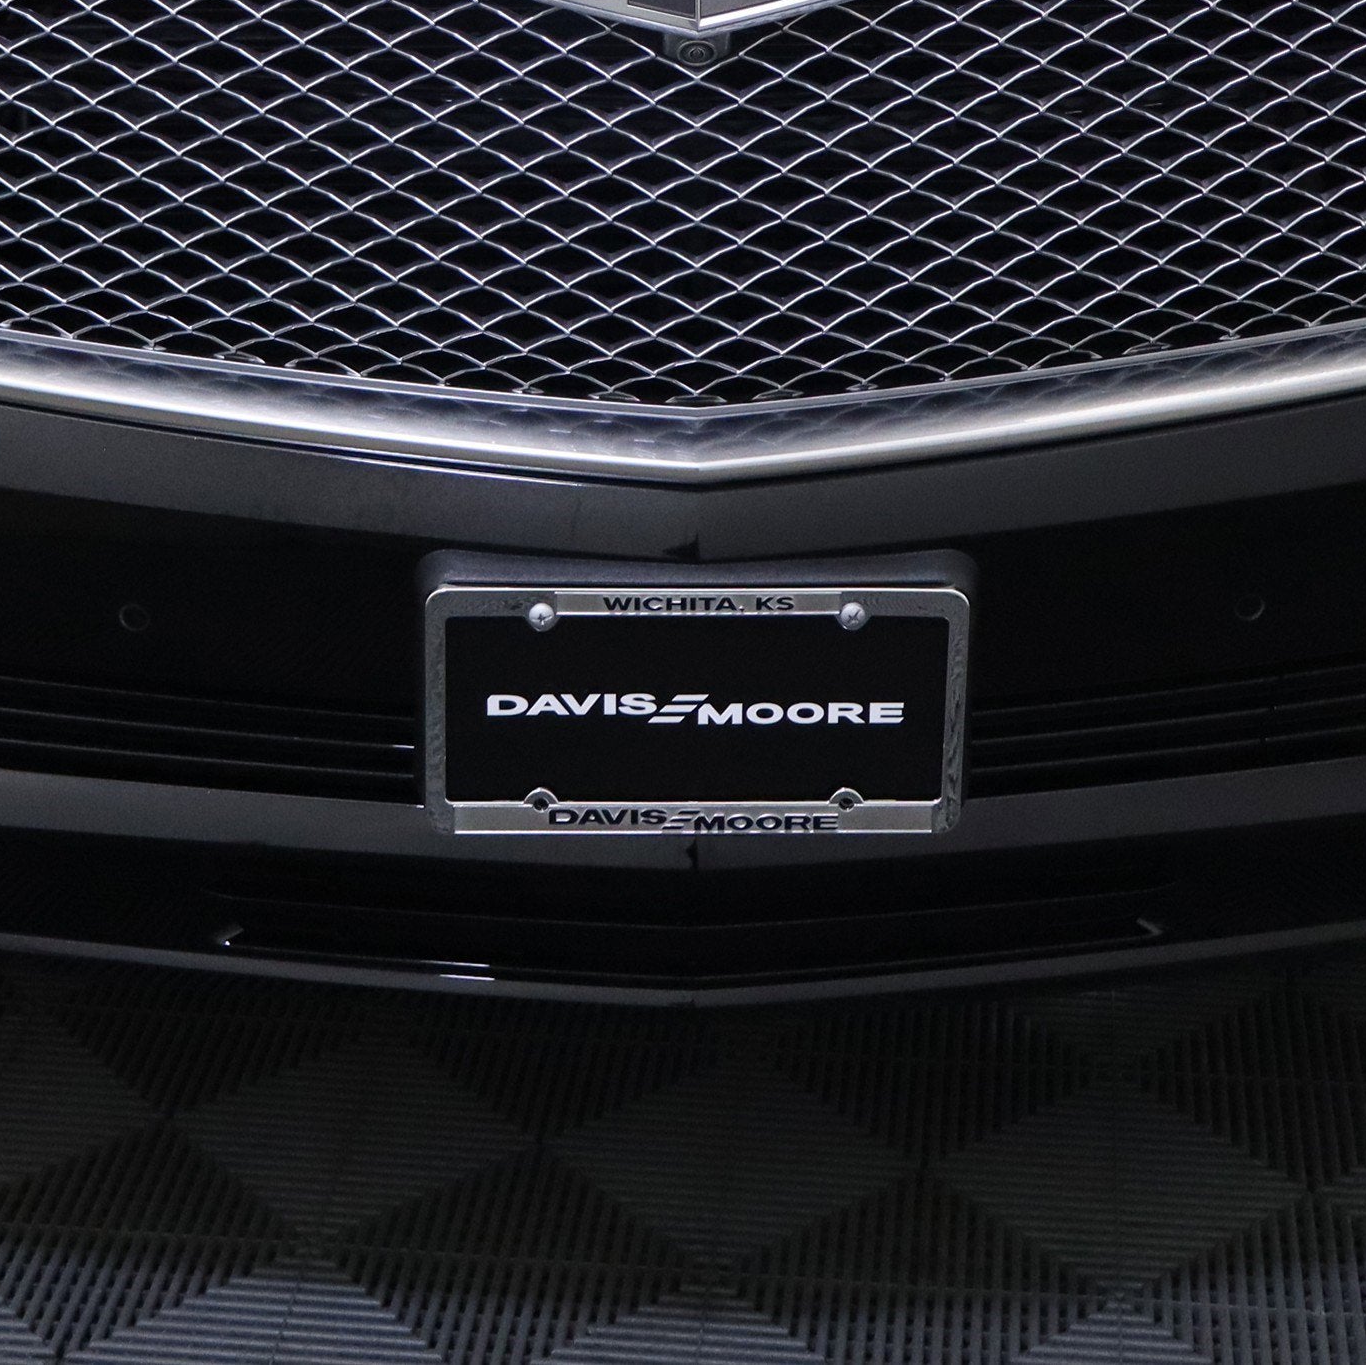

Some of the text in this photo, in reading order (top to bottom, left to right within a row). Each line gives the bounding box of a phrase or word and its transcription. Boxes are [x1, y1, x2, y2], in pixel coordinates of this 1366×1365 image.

[755, 596, 795, 612] KS
[486, 693, 905, 725] DAVIS MOORE
[548, 808, 840, 832] DAVIS MOORE
